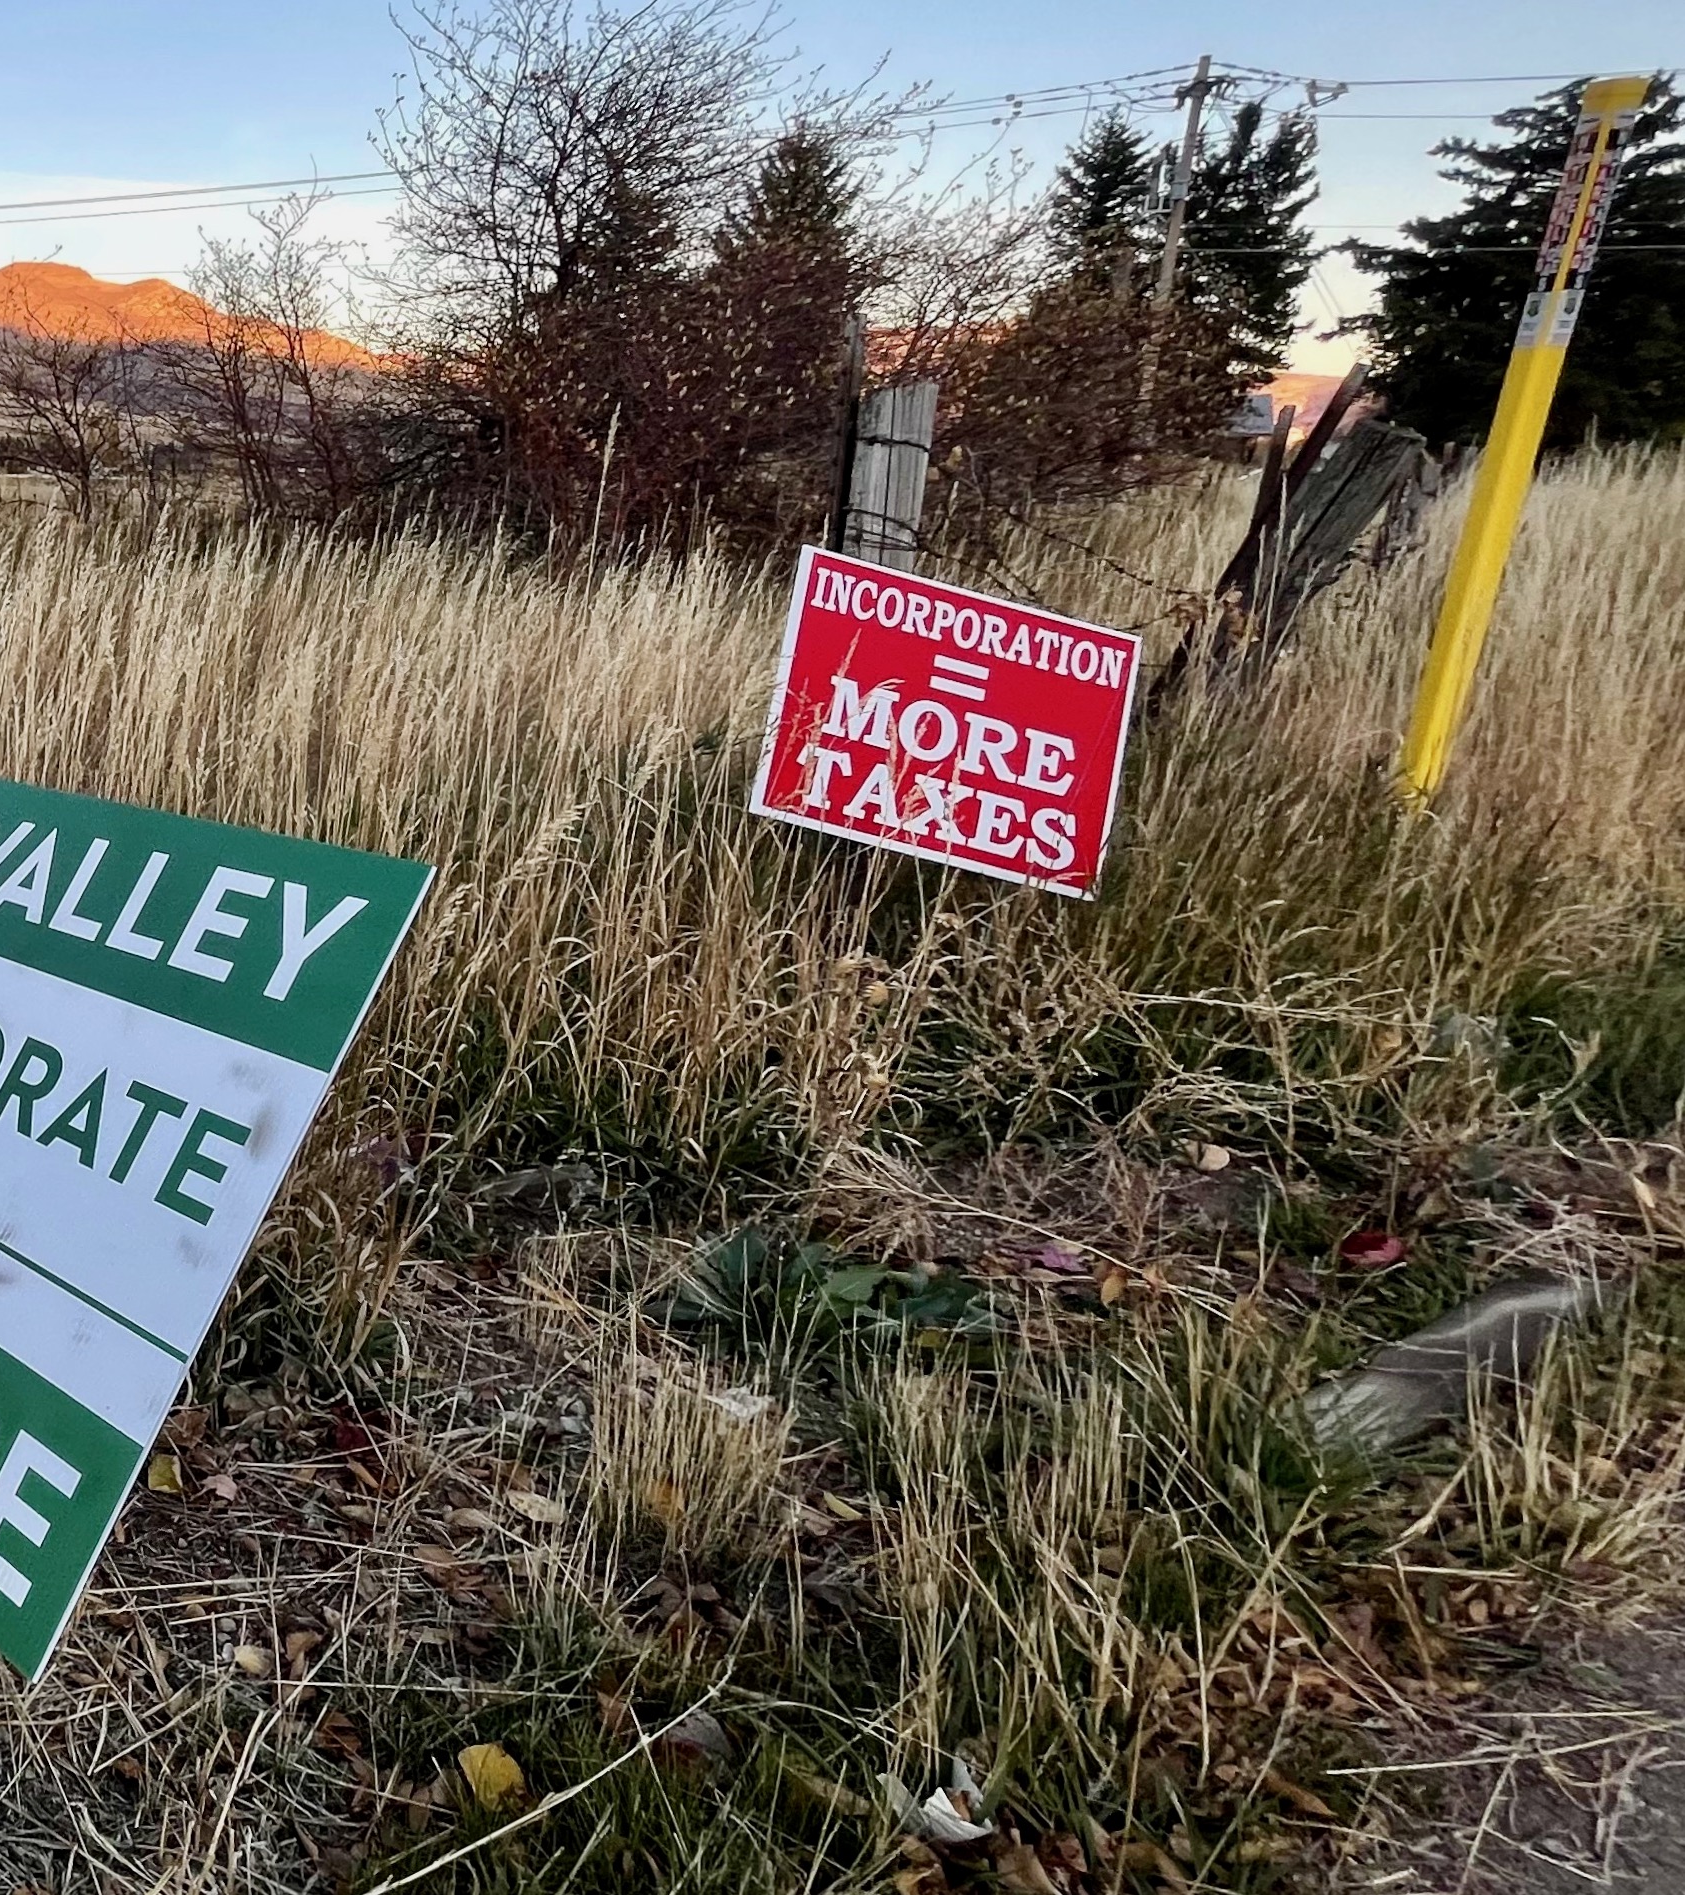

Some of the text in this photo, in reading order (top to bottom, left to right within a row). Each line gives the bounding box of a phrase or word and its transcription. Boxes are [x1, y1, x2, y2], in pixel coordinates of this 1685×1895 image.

[811, 568, 1126, 688] INCORPORATION
[821, 676, 1076, 796] MORE
[796, 747, 1076, 870] TAXES
